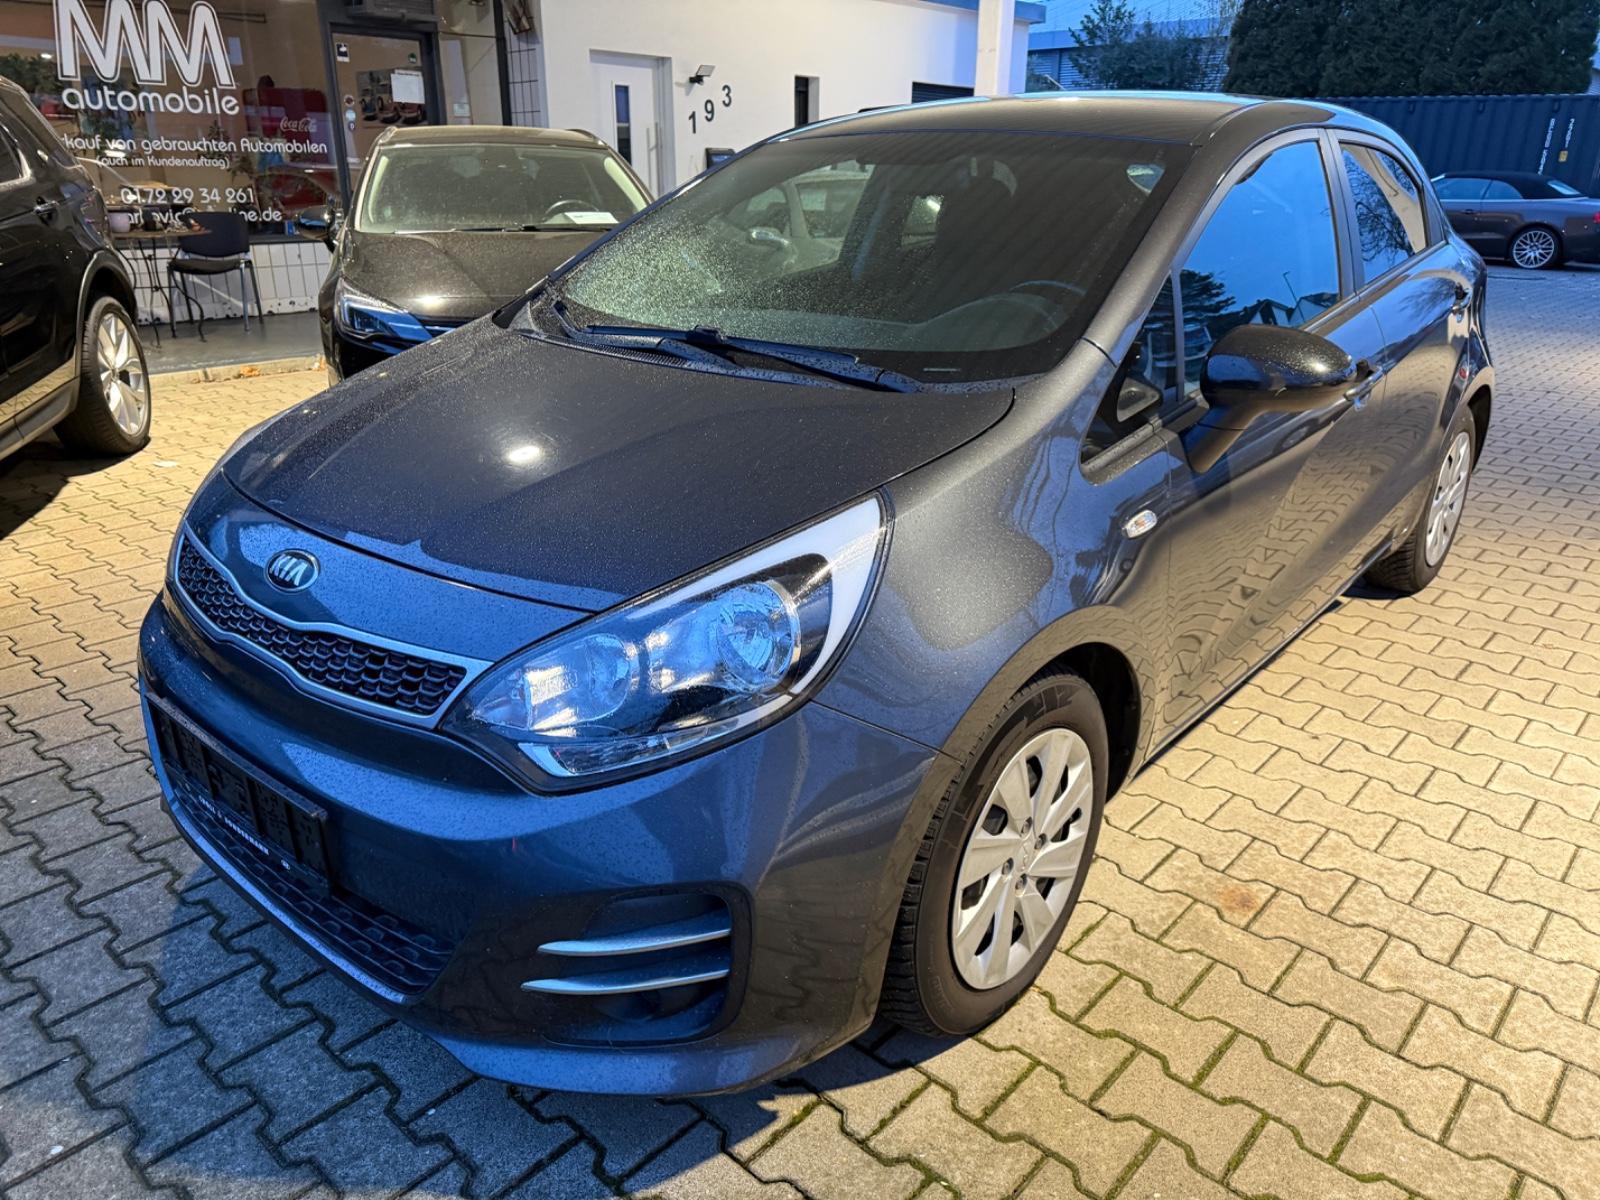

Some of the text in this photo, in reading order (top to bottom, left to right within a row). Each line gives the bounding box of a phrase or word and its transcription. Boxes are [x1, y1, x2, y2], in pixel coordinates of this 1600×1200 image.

[53, 0, 236, 89] MM
[62, 85, 240, 116] automobile
[61, 132, 328, 156] kauf von gebrauchten Automobilen
[131, 155, 145, 167] im
[146, 155, 231, 170] Kundenauftrag)
[171, 187, 195, 205] 29
[198, 186, 222, 204] 34
[224, 186, 255, 204] 261
[269, 553, 308, 587] KIA
